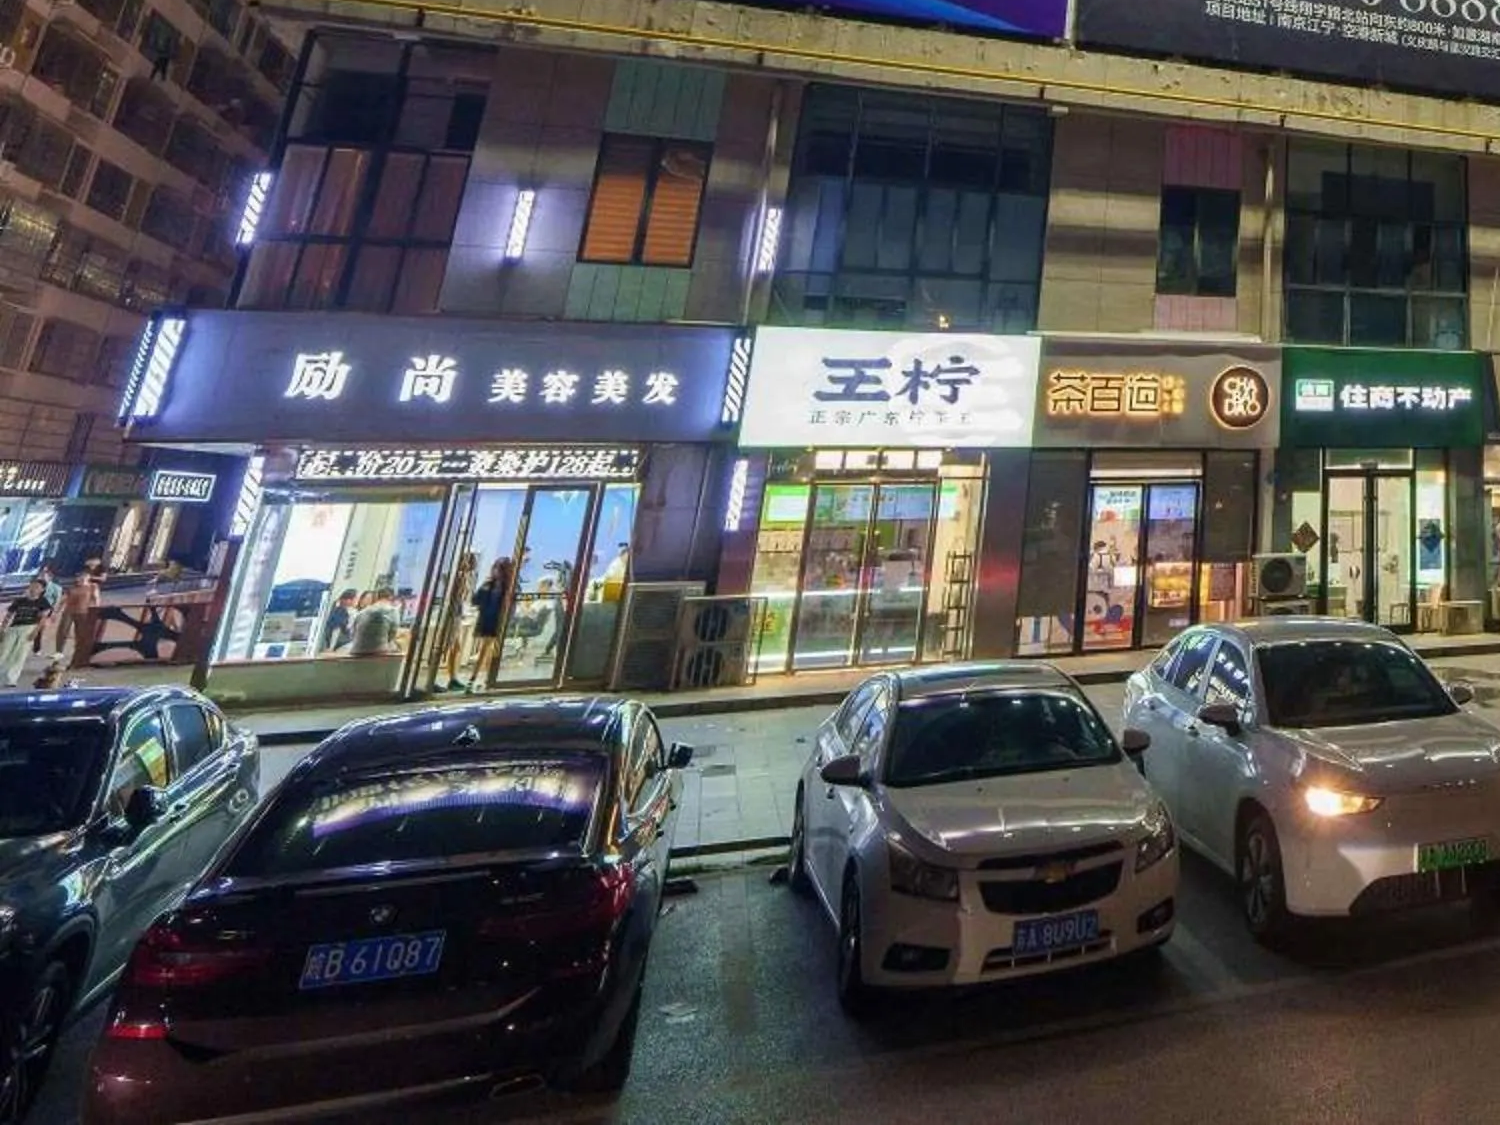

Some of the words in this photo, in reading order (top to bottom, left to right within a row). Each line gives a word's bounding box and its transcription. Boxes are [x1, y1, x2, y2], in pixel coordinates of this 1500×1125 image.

[283, 351, 457, 404] 励尚
[487, 369, 680, 405] 美容美发
[1048, 371, 1160, 415] 茶百道
[1340, 384, 1472, 410] 住商不动产
